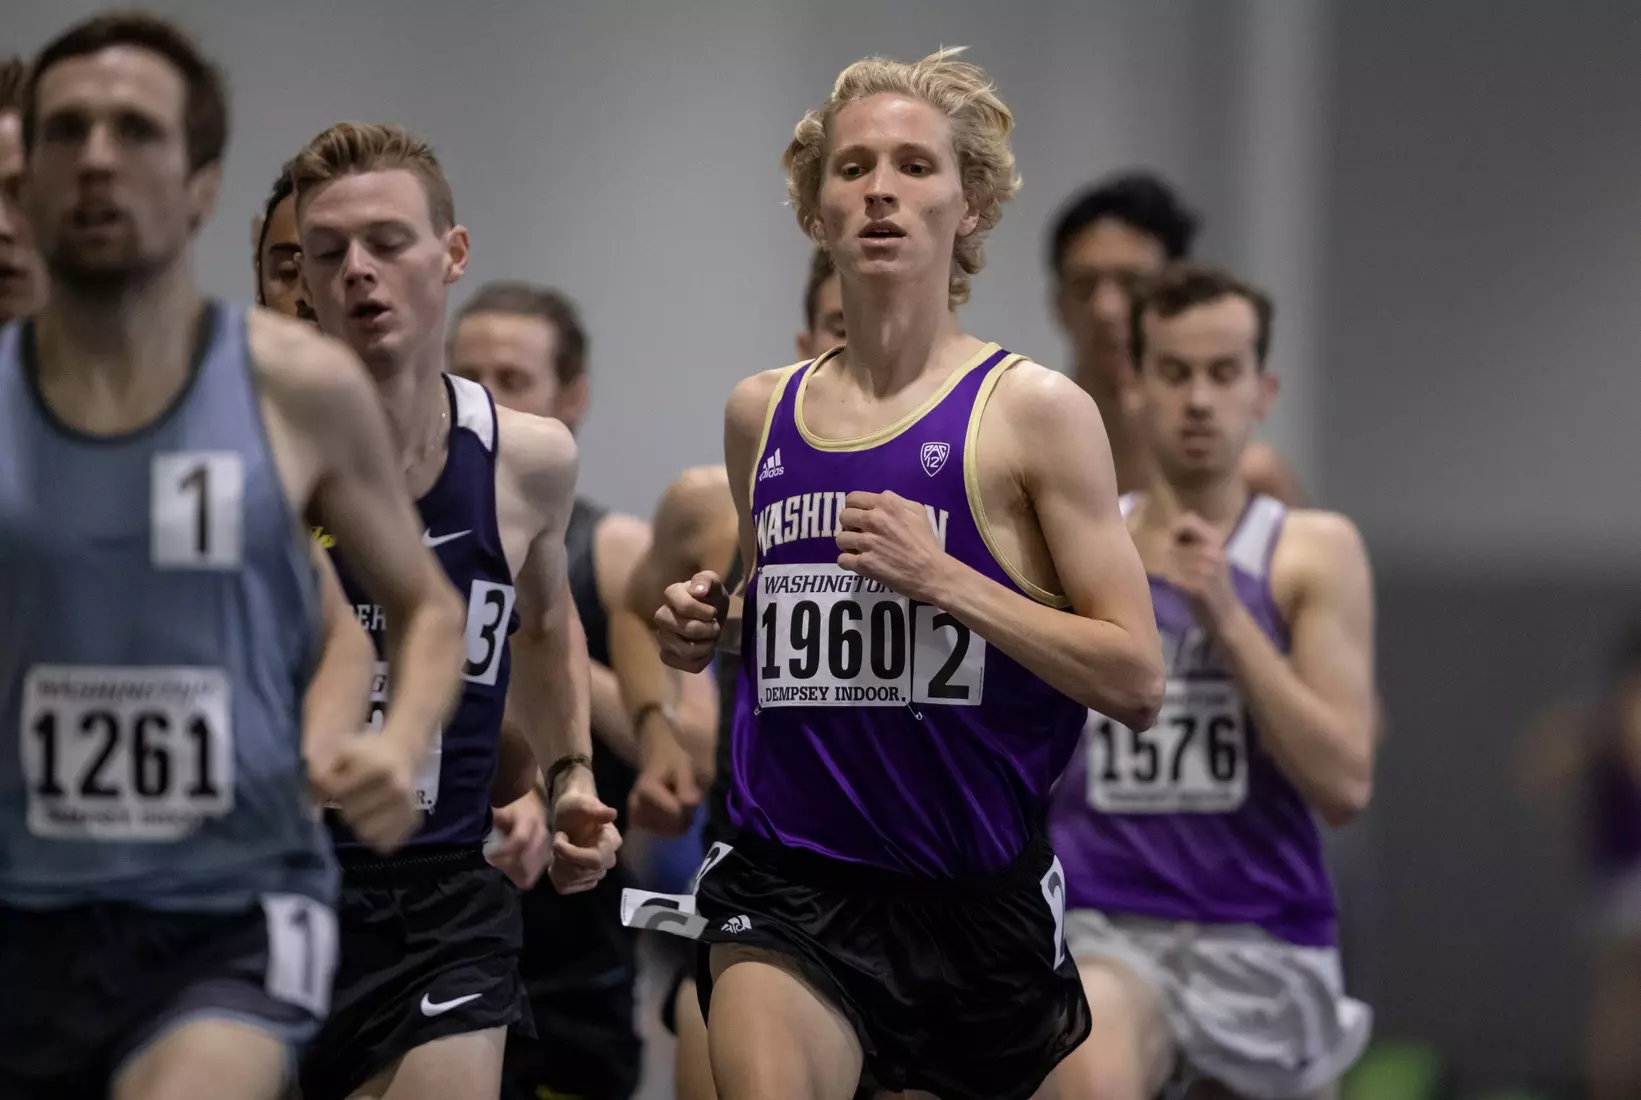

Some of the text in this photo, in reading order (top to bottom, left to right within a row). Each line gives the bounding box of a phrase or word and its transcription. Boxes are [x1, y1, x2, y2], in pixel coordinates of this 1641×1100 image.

[924, 445, 947, 461] PAC
[926, 456, 940, 468] 12
[178, 463, 210, 557] 1
[462, 589, 506, 676] 3
[761, 599, 906, 680] 1960
[927, 611, 971, 700] 2
[765, 686, 900, 702] DEMPSEY INDOOR
[34, 709, 218, 798] 1261
[1097, 716, 1237, 783] 1576
